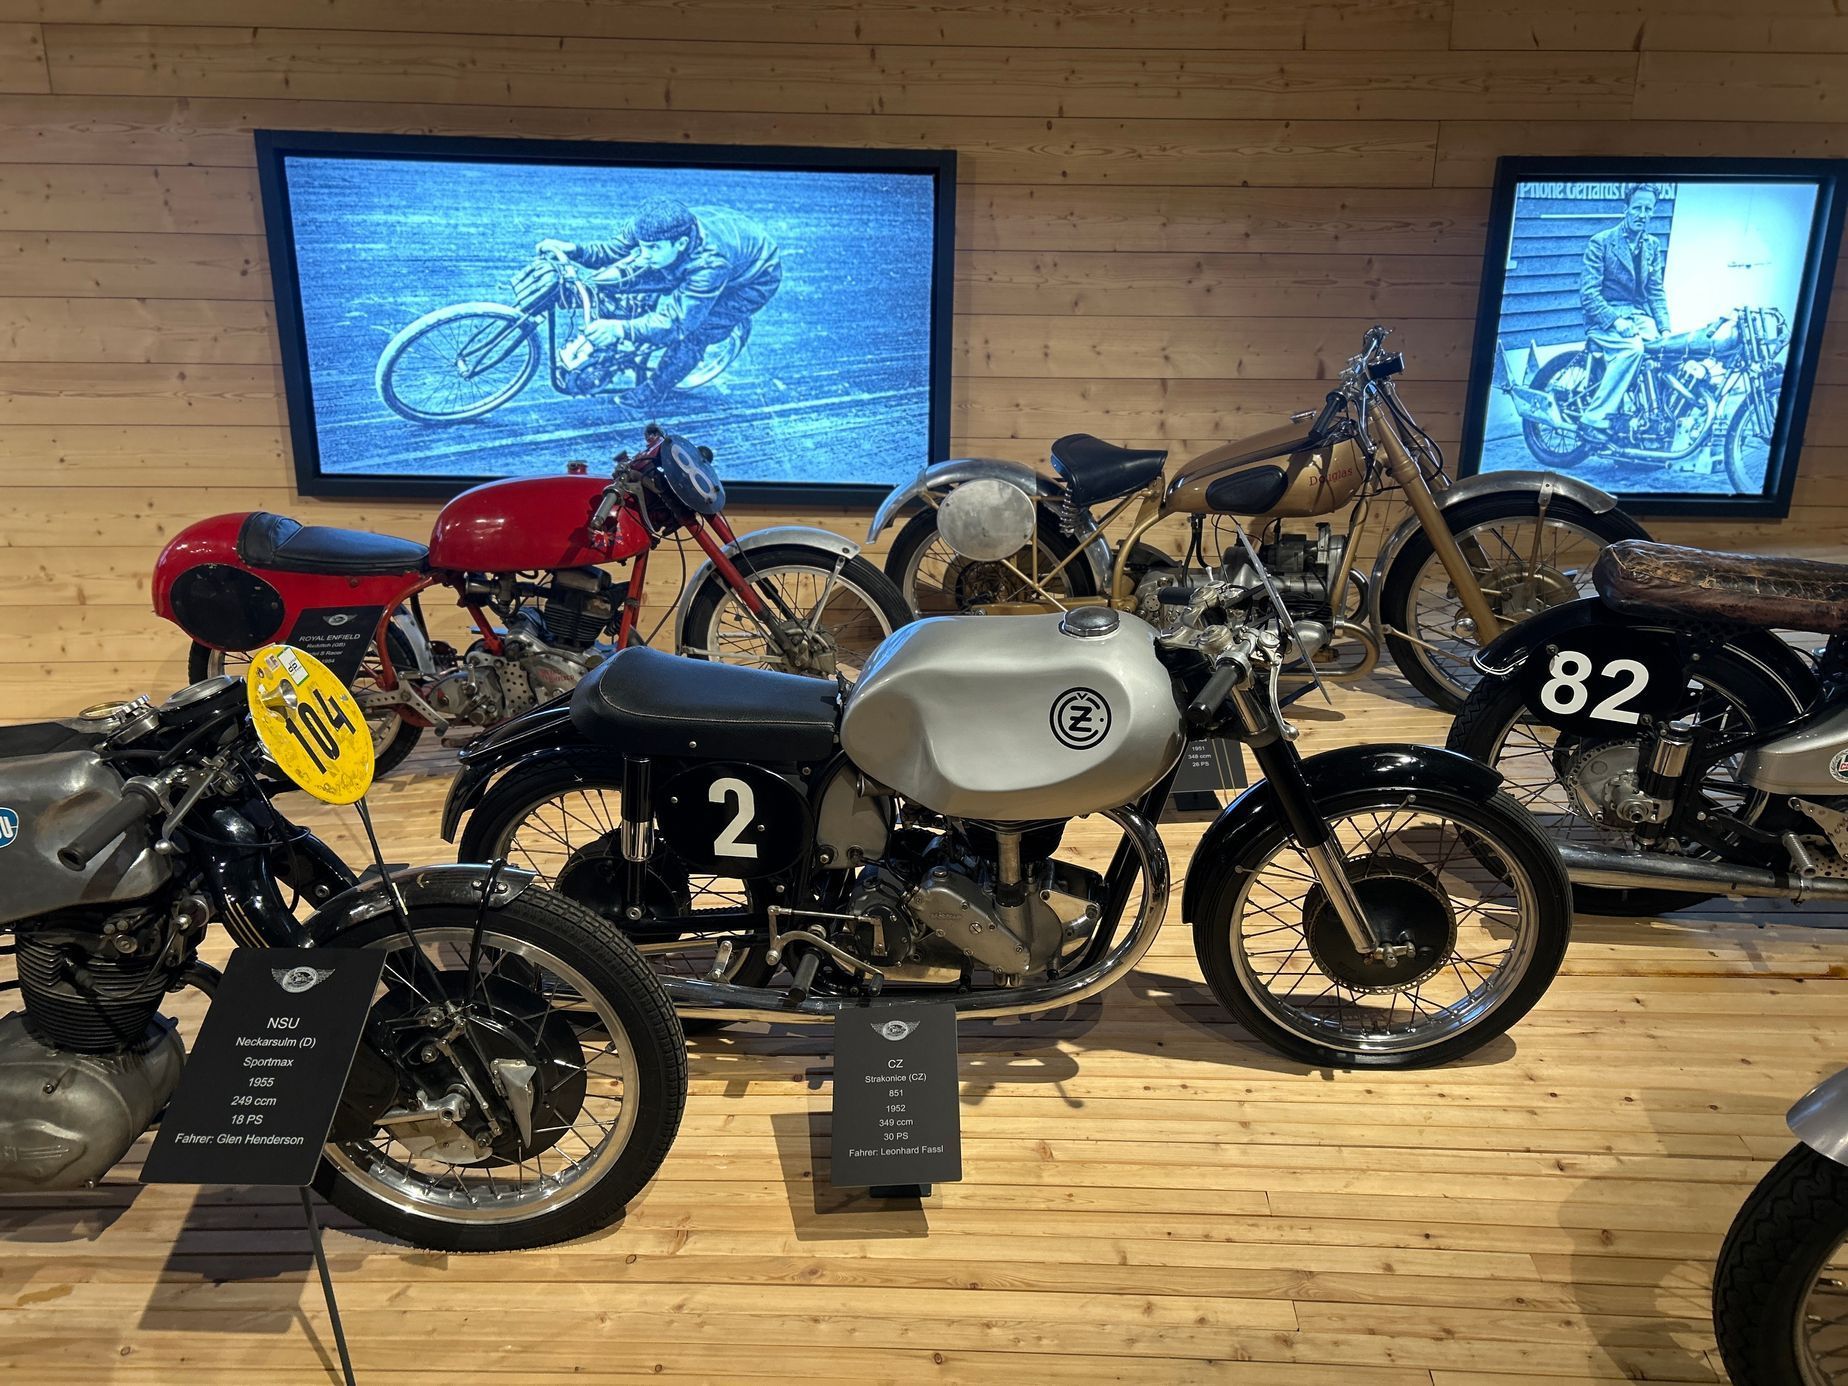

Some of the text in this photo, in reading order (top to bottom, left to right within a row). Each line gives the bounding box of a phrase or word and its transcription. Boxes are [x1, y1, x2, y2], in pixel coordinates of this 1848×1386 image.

[671, 444, 717, 502] 8
[1541, 650, 1649, 725] 82
[286, 689, 356, 775] 104
[708, 777, 758, 859] 2
[267, 1017, 300, 1029] NSU
[235, 1037, 317, 1049] Neckarsulm (D)
[243, 1057, 294, 1068] Sportmax
[887, 1059, 904, 1069] CZ
[248, 1077, 275, 1087] 1955
[864, 1073, 927, 1084] Strakonice (CZ)
[888, 1089, 904, 1097] 851
[230, 1096, 277, 1106] 249 ccm
[886, 1104, 906, 1112] 1952
[231, 1115, 263, 1125] 18 PS
[879, 1118, 914, 1127] 349 ccm
[175, 1133, 304, 1145] Fahrer: Glen Henderson
[883, 1132, 909, 1141] 30 PS
[849, 1144, 944, 1158] Fahrer: Leonhard Fassl
